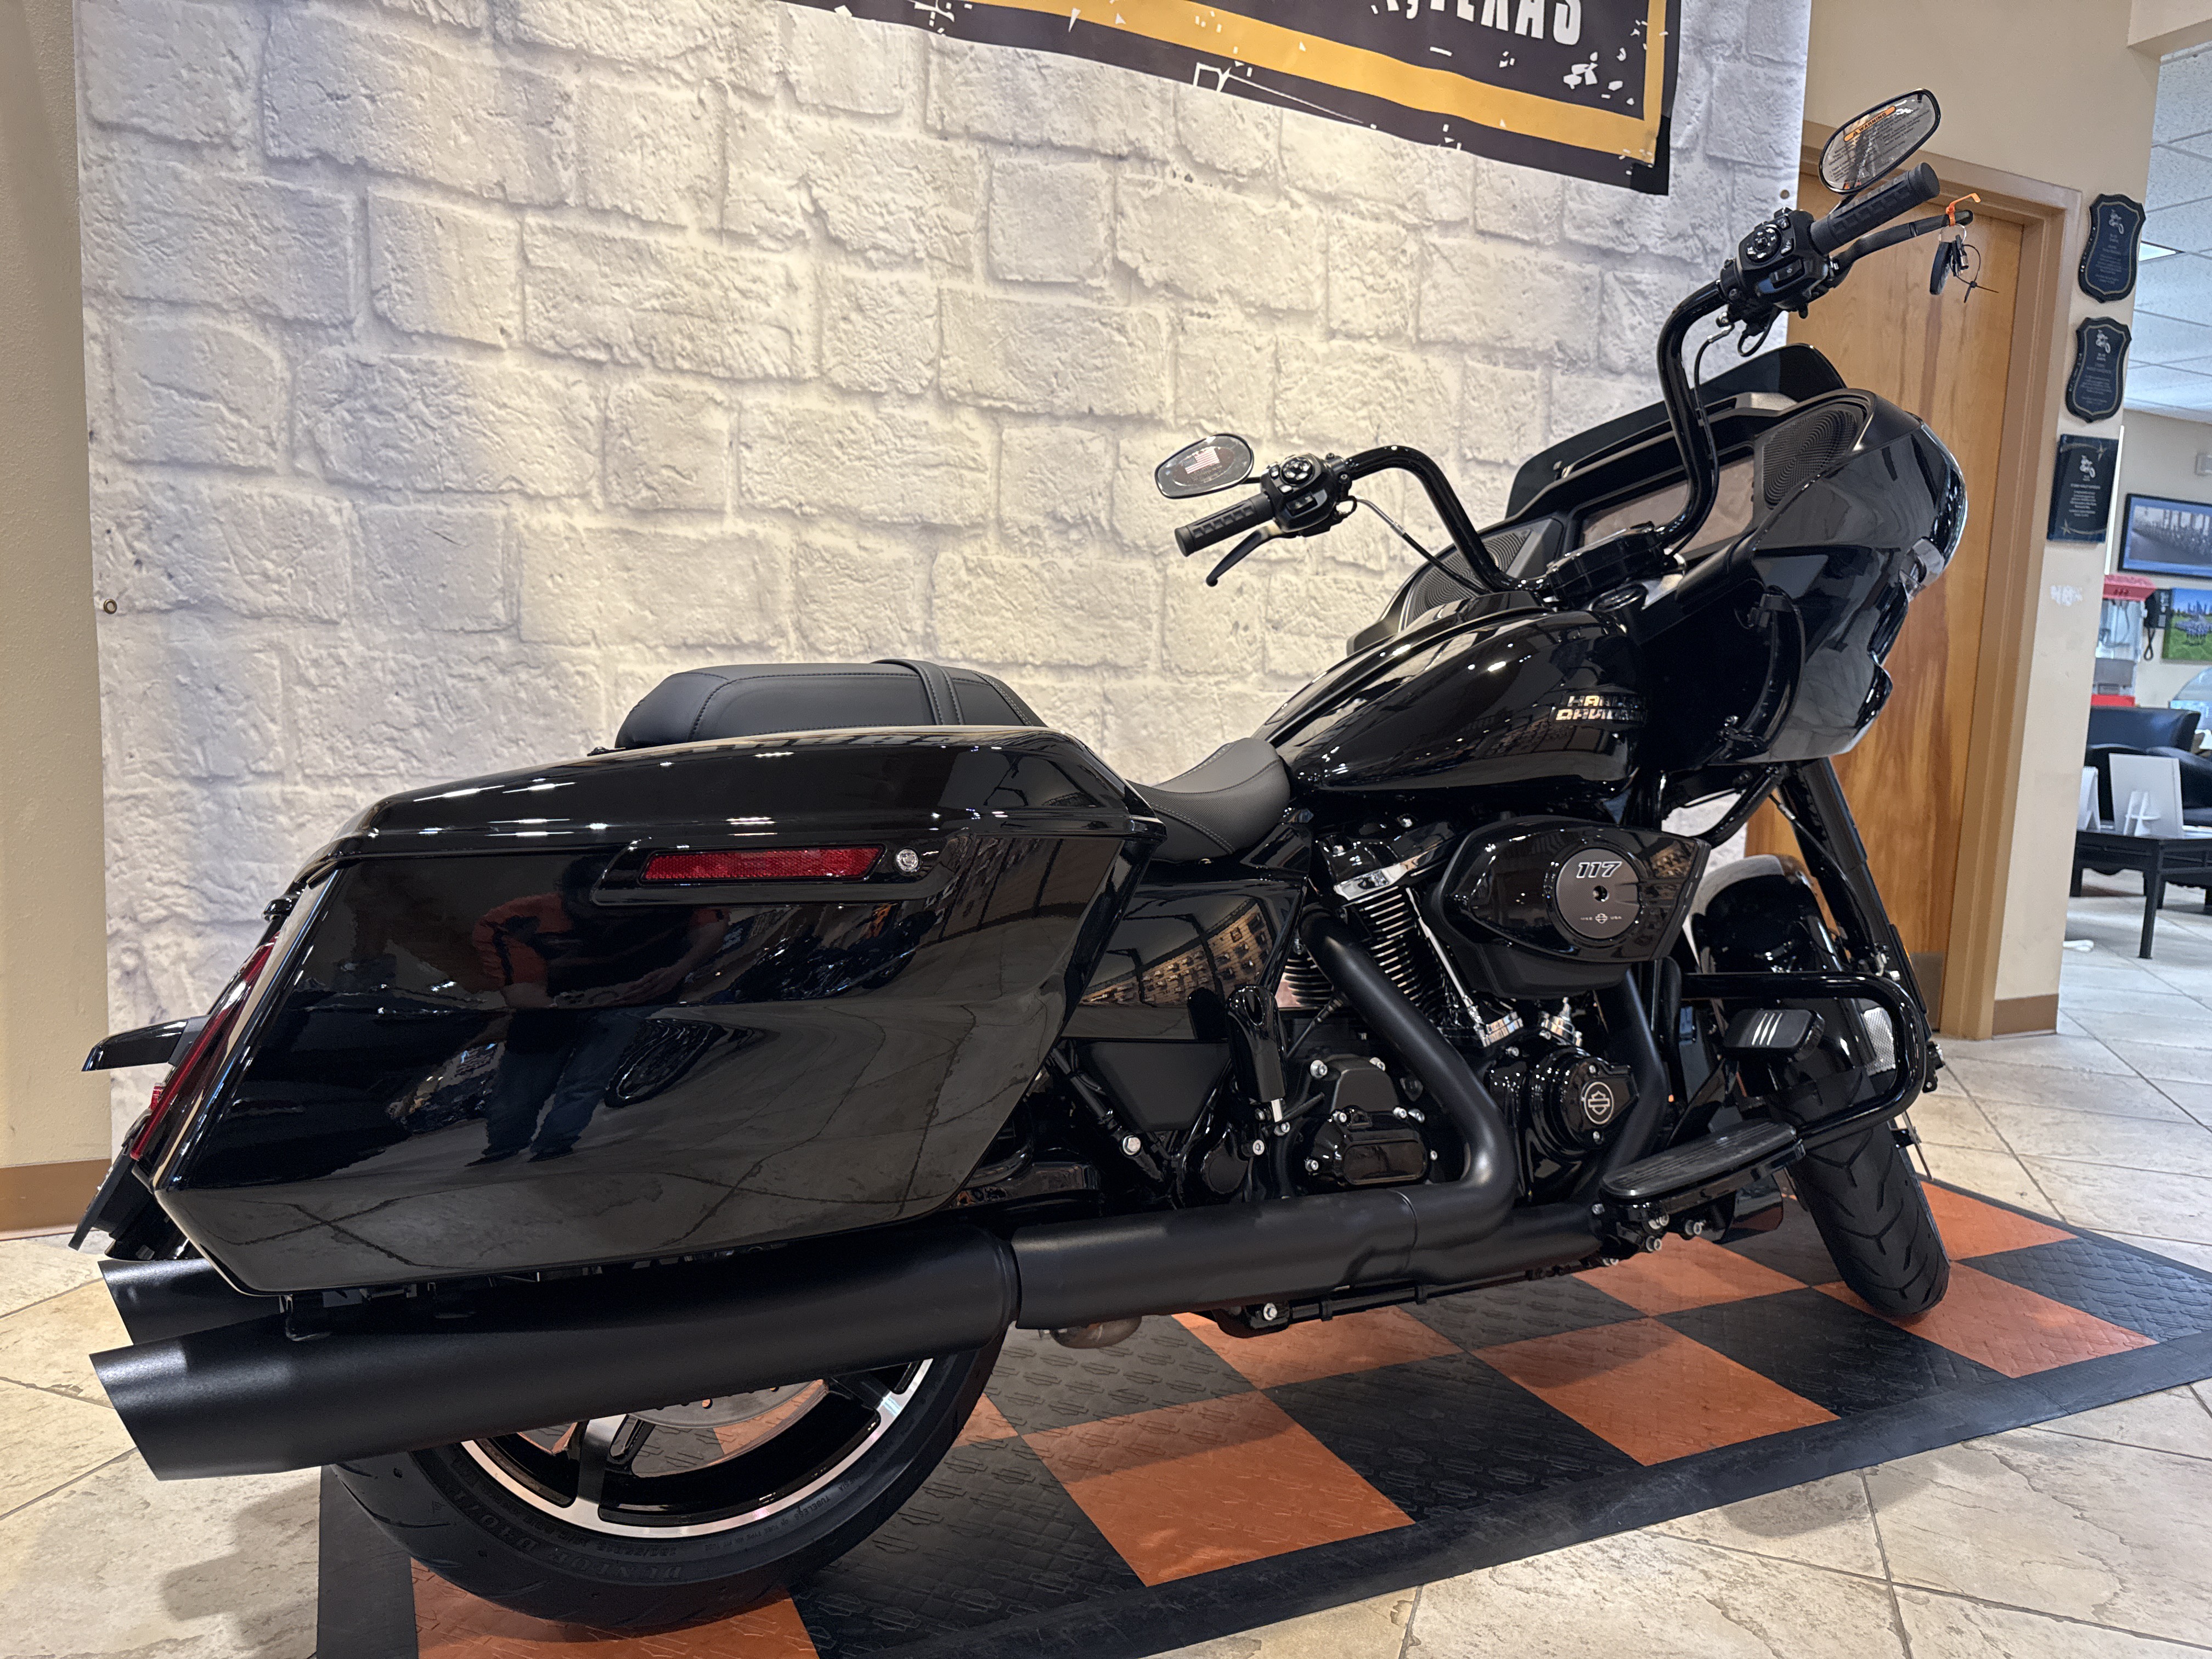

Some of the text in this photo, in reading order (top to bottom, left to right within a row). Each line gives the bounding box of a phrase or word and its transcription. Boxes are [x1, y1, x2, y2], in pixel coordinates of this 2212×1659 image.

[1430, 0, 1581, 46] XAS
[1859, 112, 1887, 131] WARNING
[1555, 708, 1645, 720] DAVID
[1576, 861, 1622, 879] 117
[793, 1496, 831, 1520] TUBELESS
